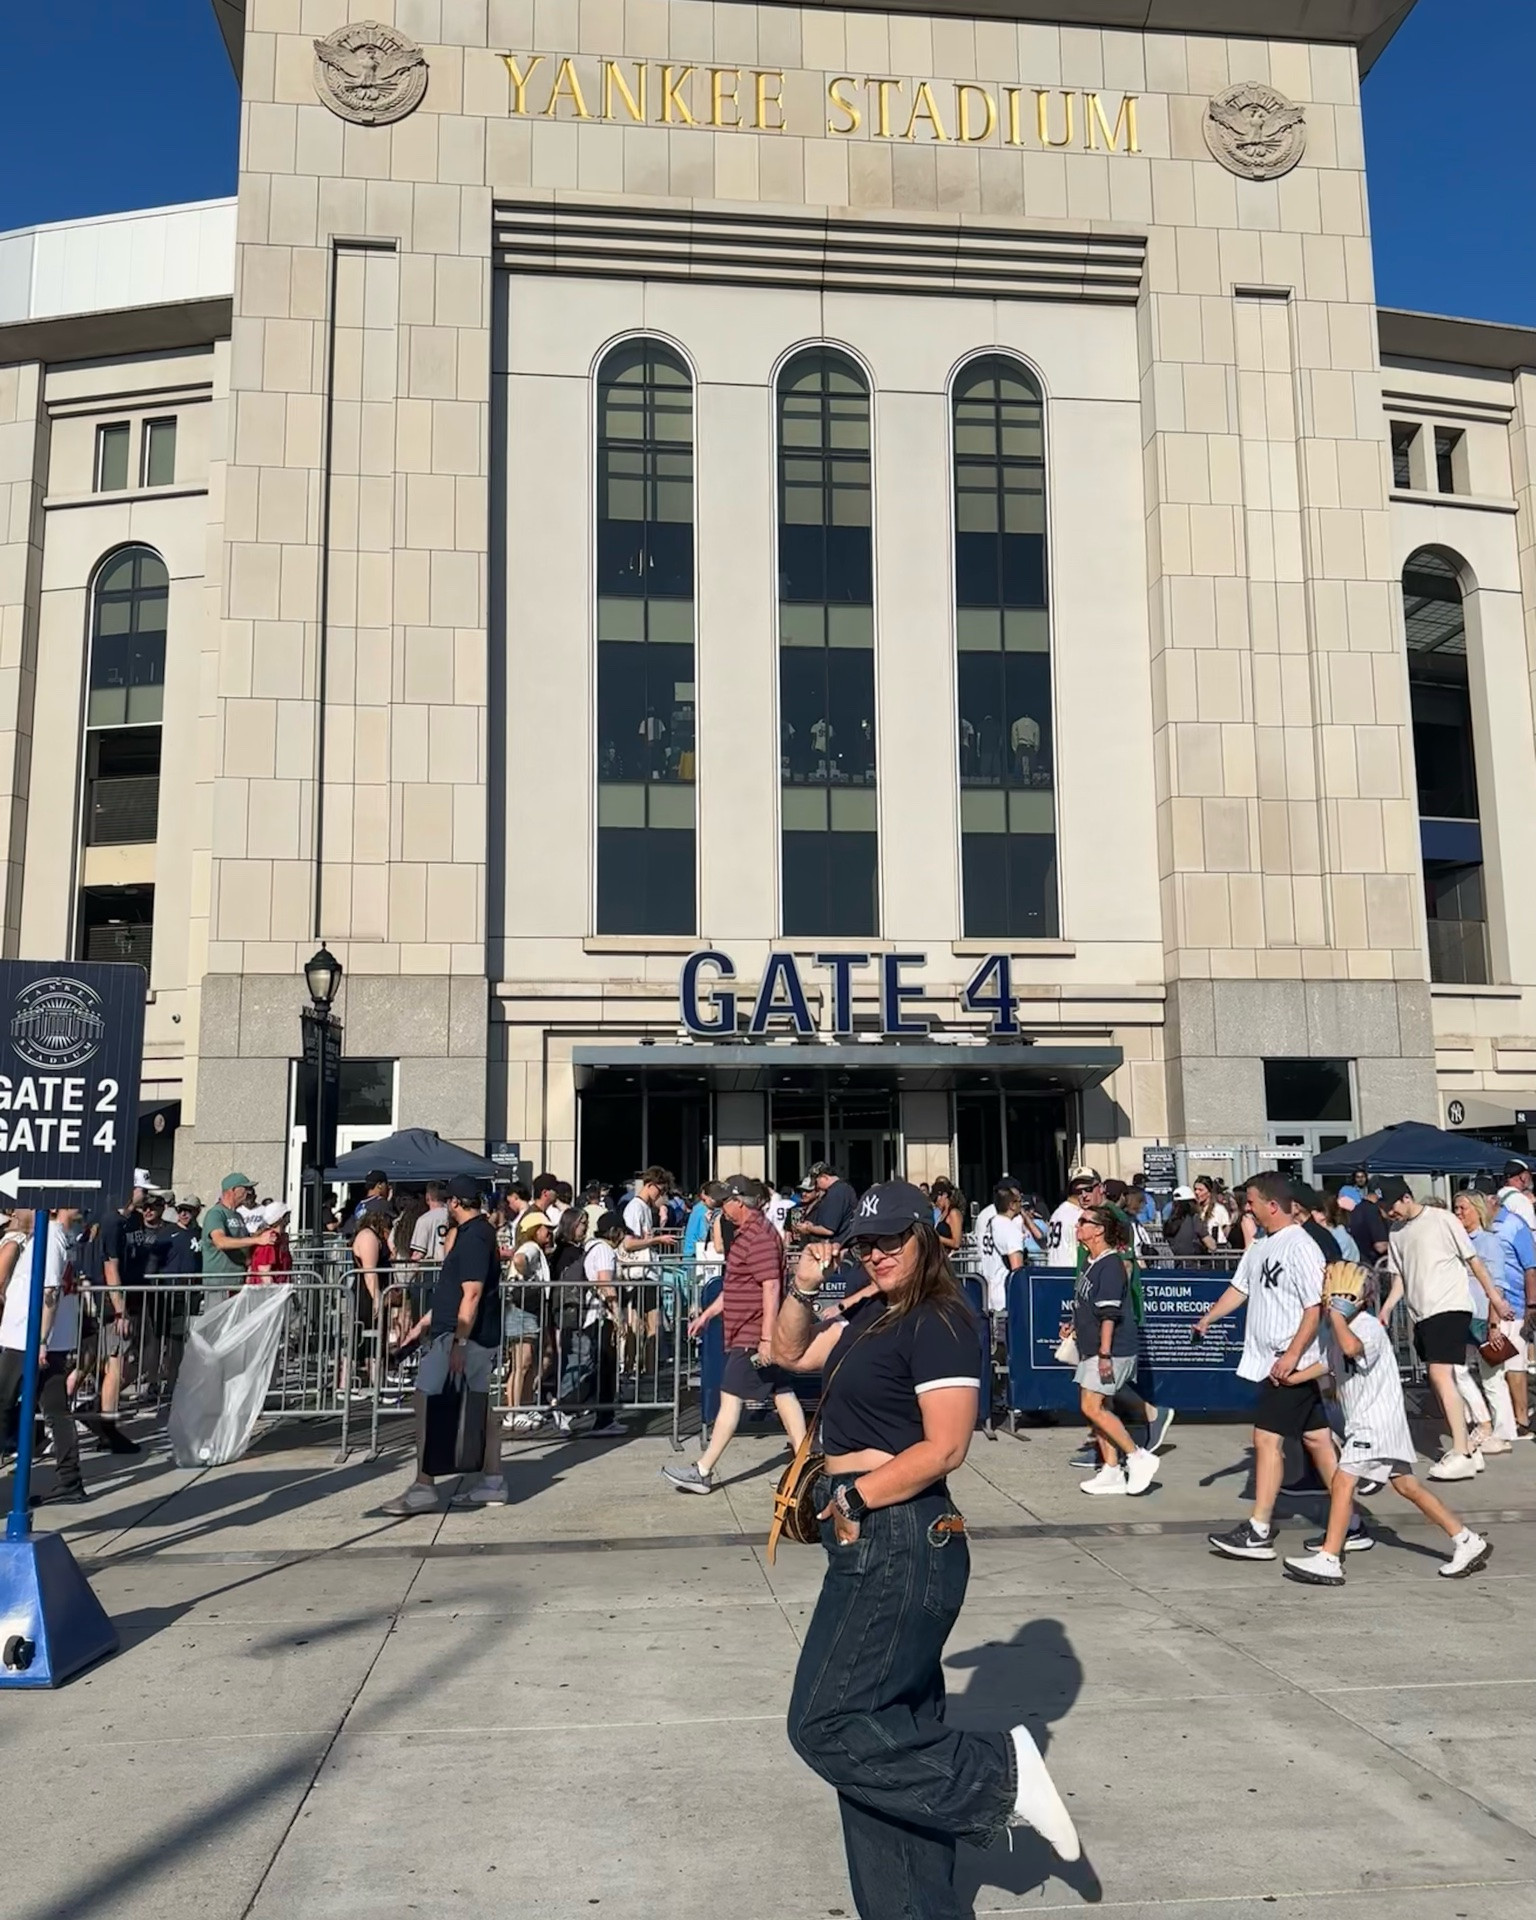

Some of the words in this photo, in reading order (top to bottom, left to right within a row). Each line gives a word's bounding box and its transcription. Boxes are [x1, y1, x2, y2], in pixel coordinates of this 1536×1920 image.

[494, 53, 788, 132] YANKEE
[827, 76, 1142, 154] STADIUM
[23, 983, 96, 1008] YANKEE
[679, 949, 931, 1036] GATE
[959, 952, 1021, 1036] 4
[19, 1039, 93, 1064] STADIUM
[95, 1078, 119, 1112] 2
[92, 1120, 117, 1153] 4
[859, 1194, 880, 1217] NY
[1260, 1257, 1284, 1288] NY
[1146, 1286, 1192, 1297] STADIUM
[1160, 1301, 1175, 1312] OR
[1176, 1302, 1216, 1313] RECOR
